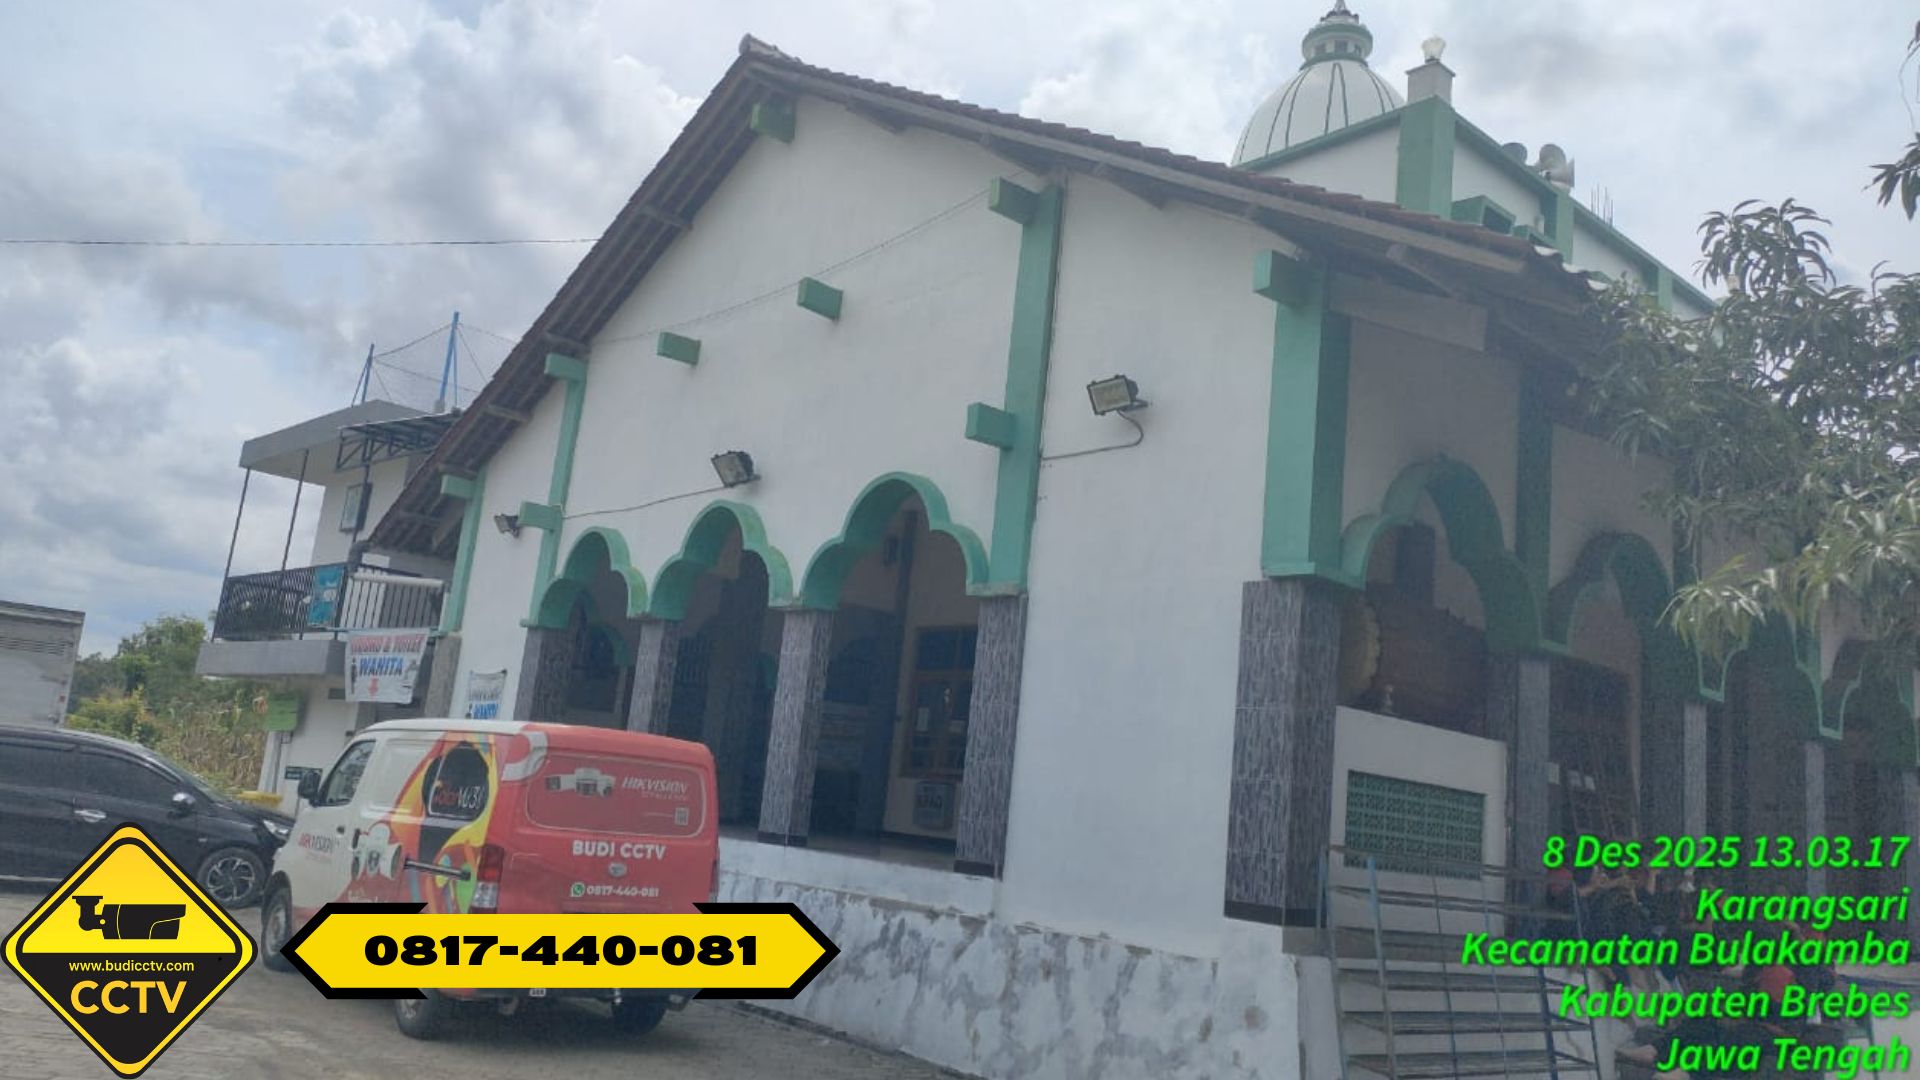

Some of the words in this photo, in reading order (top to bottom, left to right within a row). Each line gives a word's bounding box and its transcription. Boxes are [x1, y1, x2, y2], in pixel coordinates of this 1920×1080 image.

[359, 656, 404, 676] WANITA
[621, 776, 688, 794] HIKVISION
[572, 840, 615, 857] BUDI
[620, 843, 666, 860] CCTV
